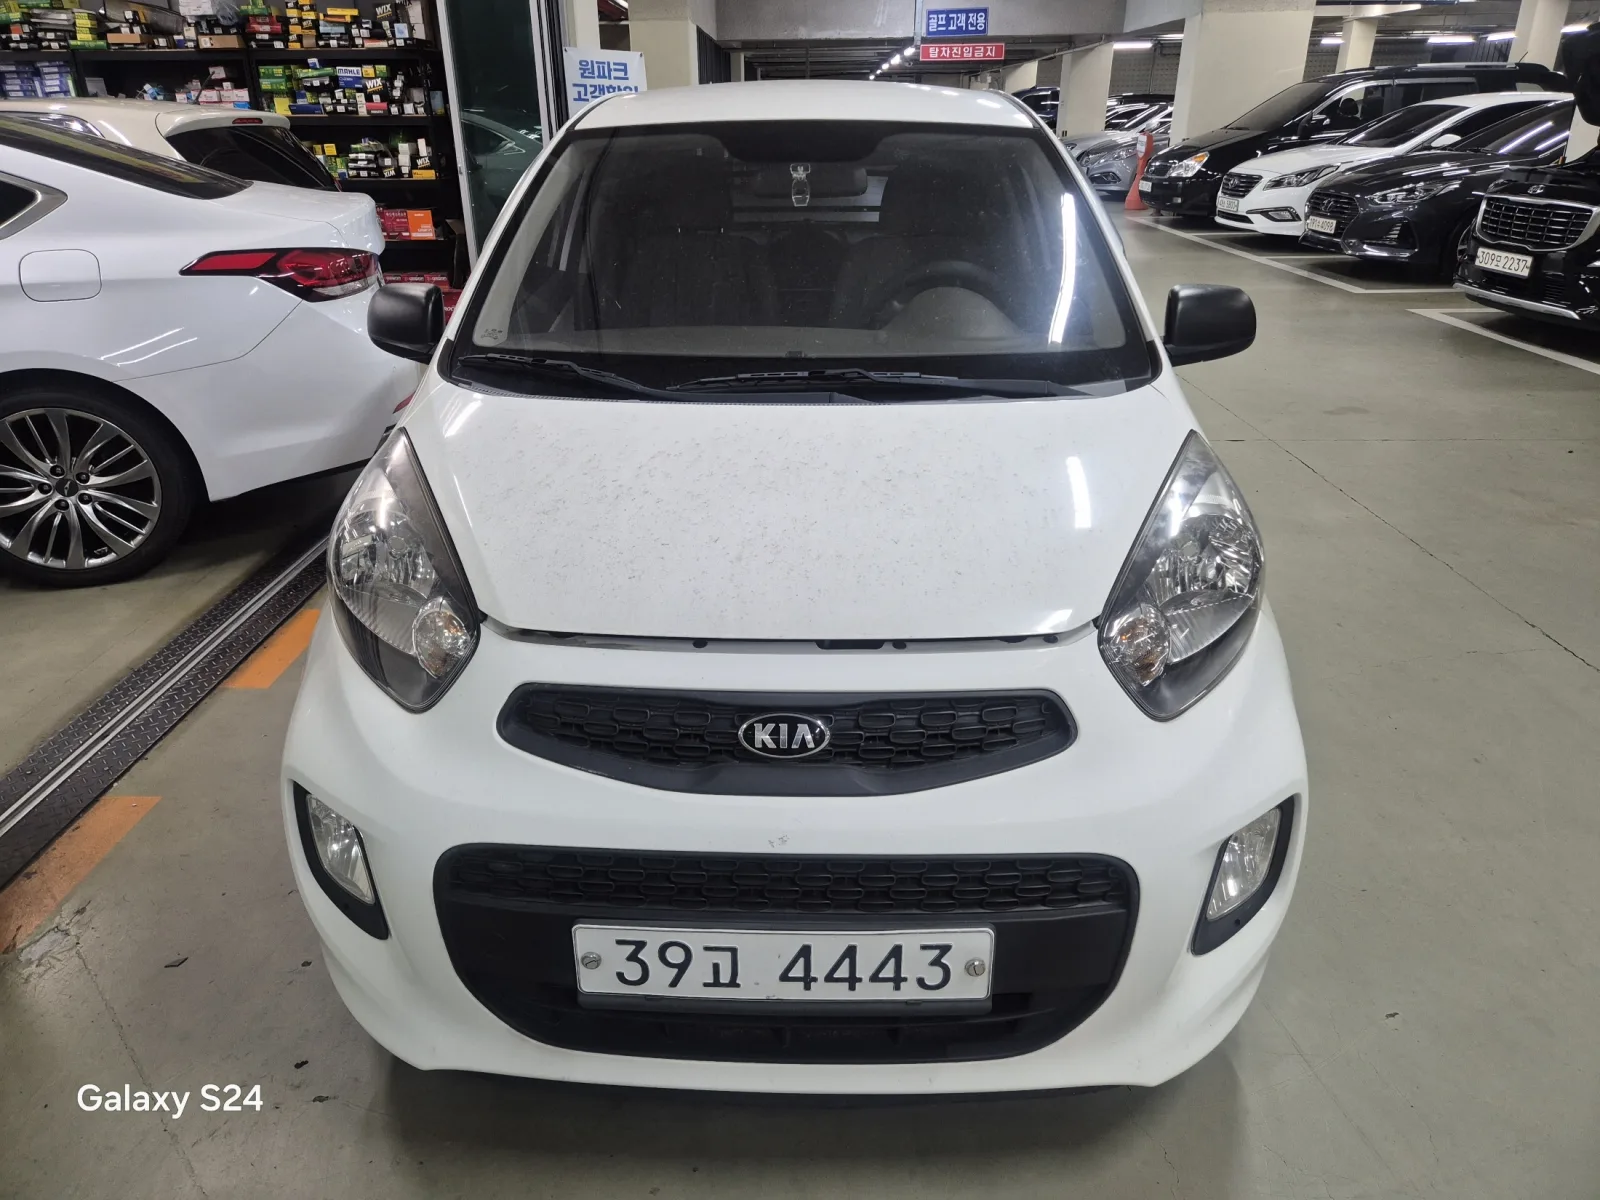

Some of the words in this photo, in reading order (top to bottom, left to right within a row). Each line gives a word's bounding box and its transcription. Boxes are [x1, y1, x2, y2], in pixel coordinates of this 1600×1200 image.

[376, 4, 392, 15] WIX
[928, 14, 947, 32] 골프
[948, 13, 967, 31] 고객
[967, 12, 986, 31] 전용
[929, 46, 996, 58] 탑차진입금지
[337, 68, 361, 76] MAHLE
[578, 59, 630, 81] 원파크
[365, 77, 383, 89] WIX
[416, 157, 430, 167] WIX
[1502, 255, 1529, 272] 2237
[753, 723, 816, 749] KIA
[614, 938, 742, 989] 39고
[778, 942, 954, 993] 4443
